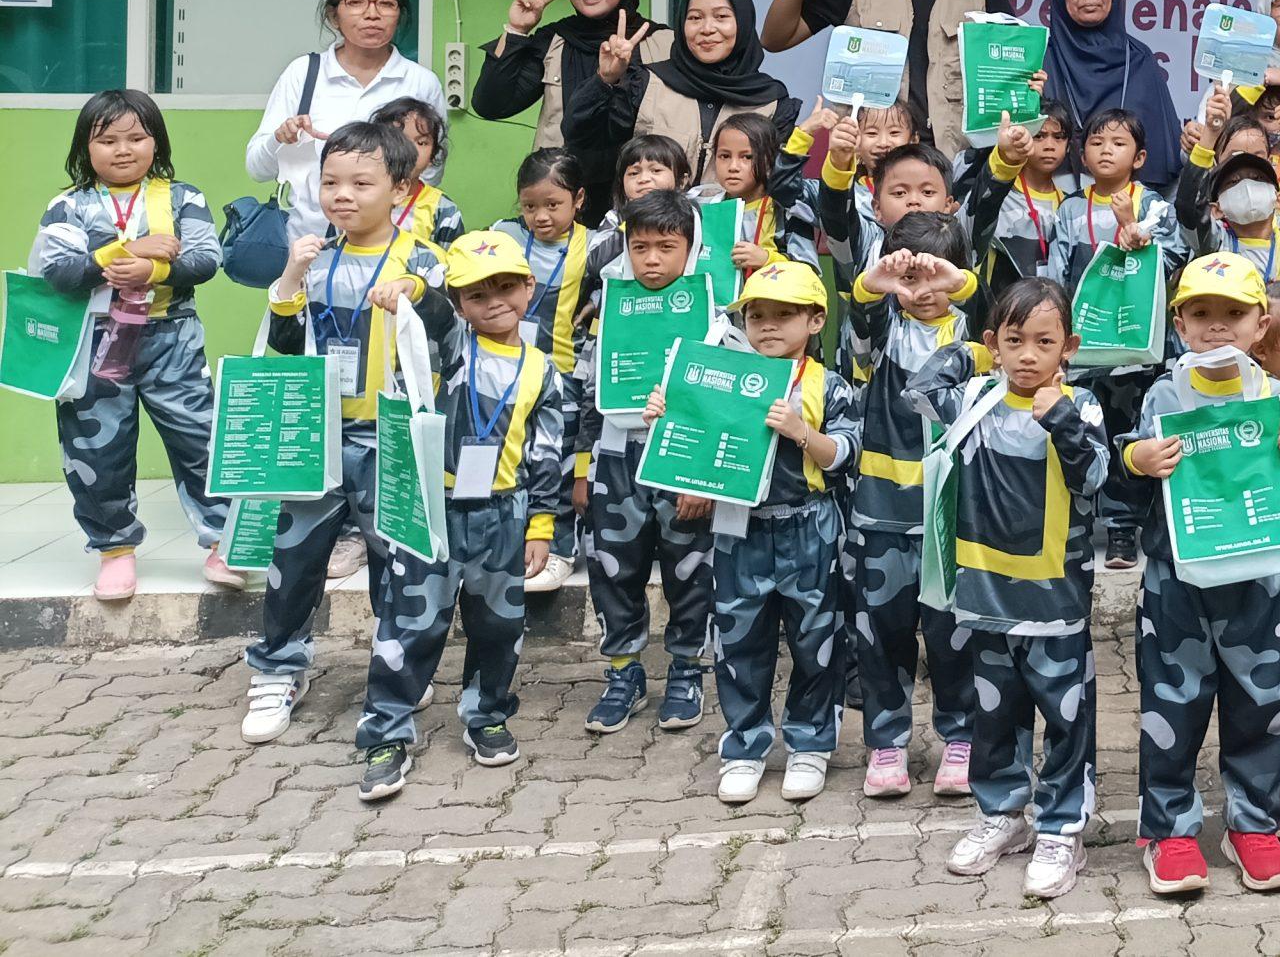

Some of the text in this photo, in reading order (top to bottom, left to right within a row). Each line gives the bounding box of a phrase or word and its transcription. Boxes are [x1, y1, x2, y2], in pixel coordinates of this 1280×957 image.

[702, 375, 735, 389] NASIONAL
[1196, 427, 1230, 440] UNIVERSITAS
[1198, 435, 1232, 448] NASIONAL
